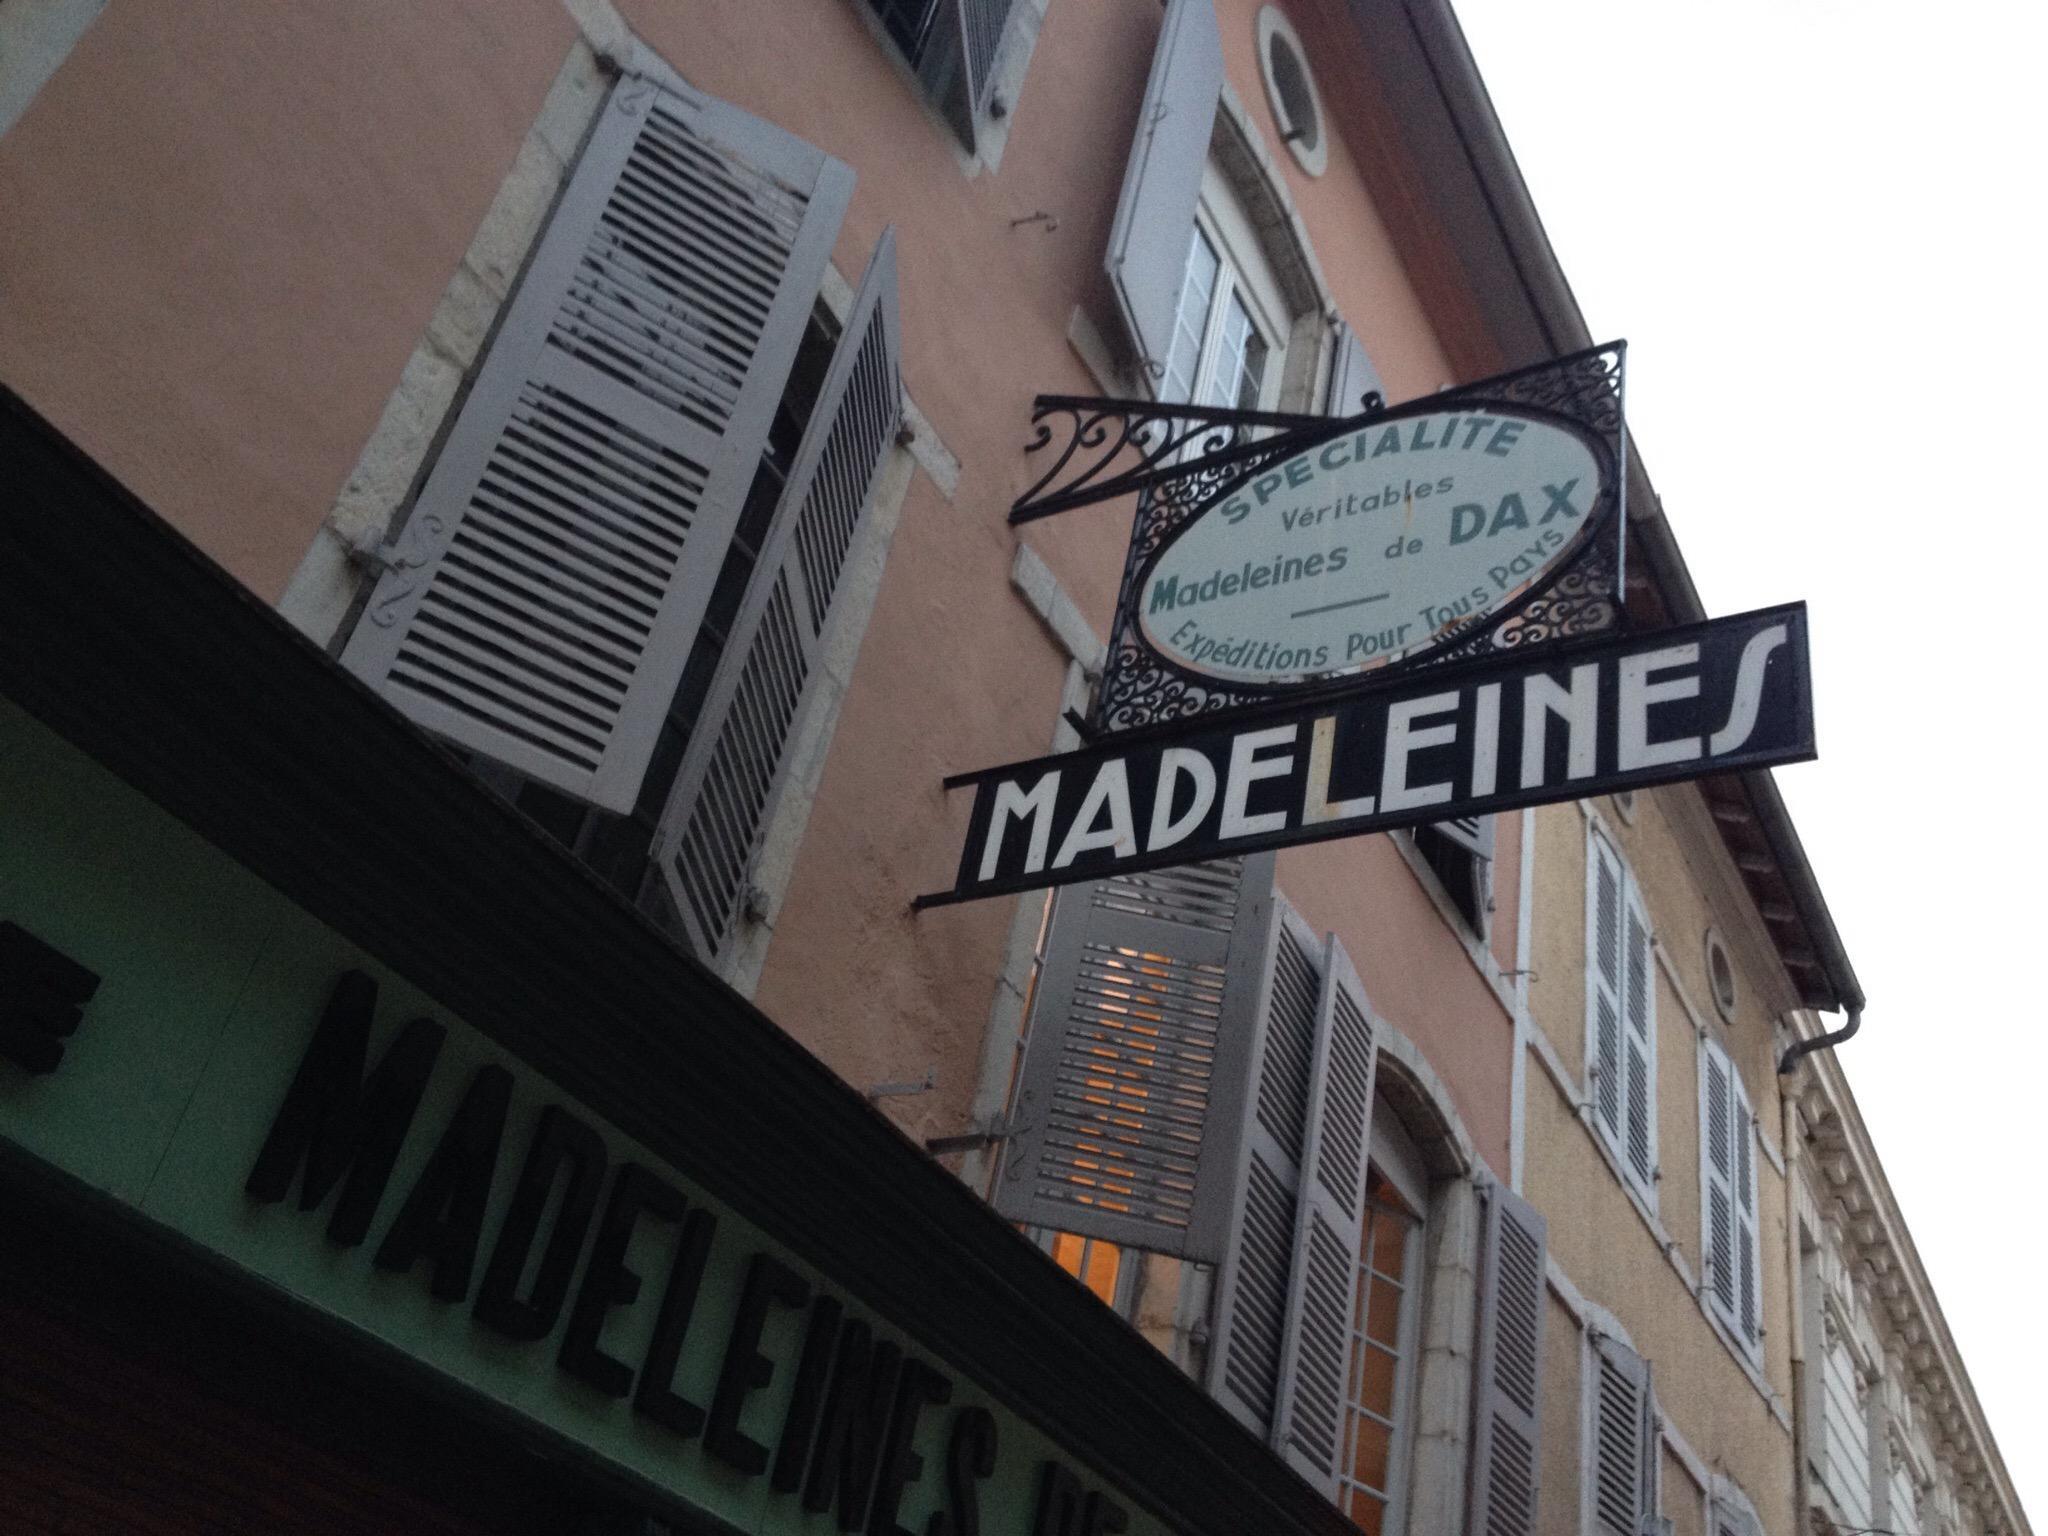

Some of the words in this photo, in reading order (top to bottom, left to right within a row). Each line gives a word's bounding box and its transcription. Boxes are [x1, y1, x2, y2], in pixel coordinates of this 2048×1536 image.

[1220, 416, 1526, 525] SPECIALITE
[1281, 475, 1454, 532] Véritables
[1148, 546, 1348, 615] Madeleines
[1385, 536, 1423, 559] de
[1449, 477, 1580, 546] DAX
[1170, 619, 1329, 671] Expéditions
[1346, 623, 1412, 660] Pour
[1418, 586, 1489, 630] Tous
[977, 624, 1788, 882] MADELEINES
[243, 967, 998, 1536] MADELEINES
